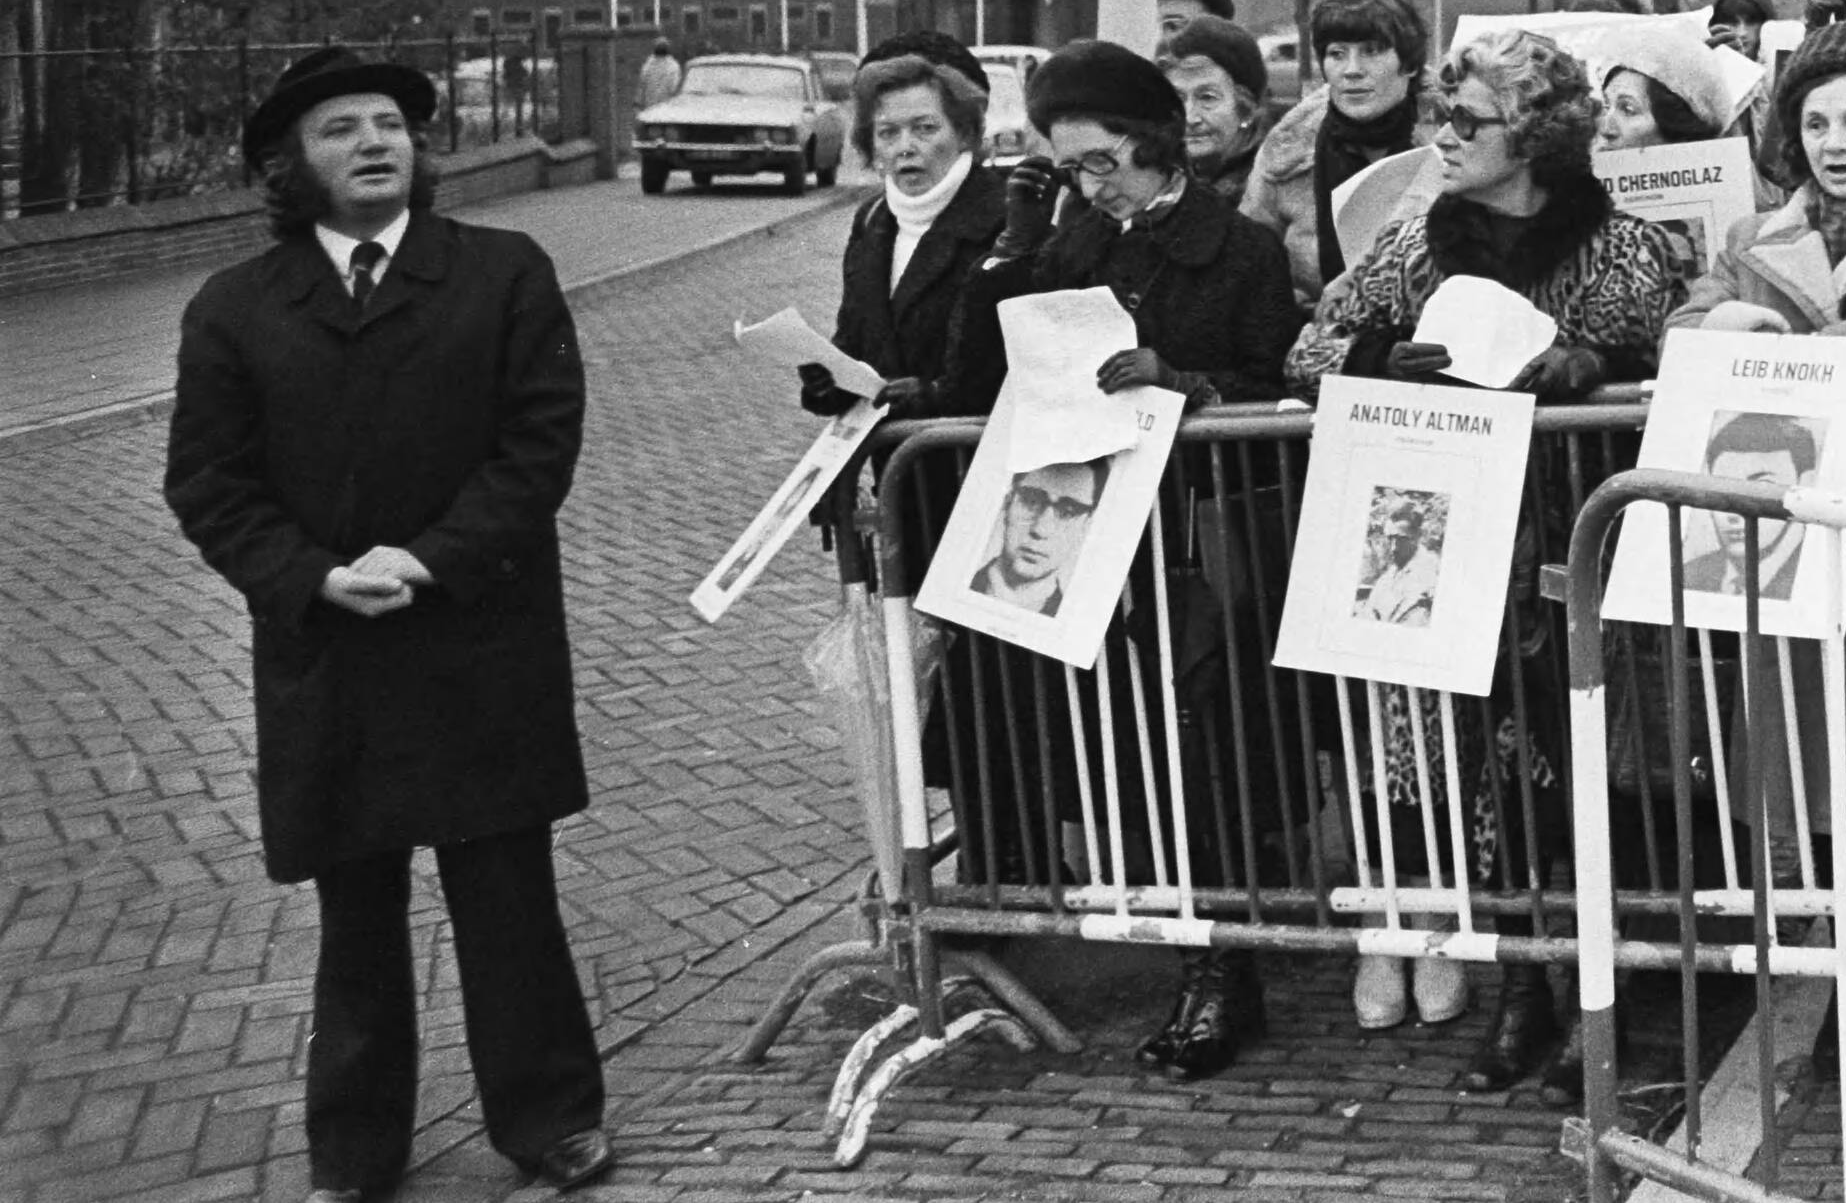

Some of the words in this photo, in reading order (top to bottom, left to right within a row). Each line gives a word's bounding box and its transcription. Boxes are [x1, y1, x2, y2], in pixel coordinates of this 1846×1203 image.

[1618, 166, 1723, 193] CHERNOGLAZ
[1732, 359, 1768, 379] LEIB
[1773, 361, 1834, 384] KNOKH
[1349, 403, 1422, 427] ANATOLY
[1426, 411, 1492, 435] ALTMAN
